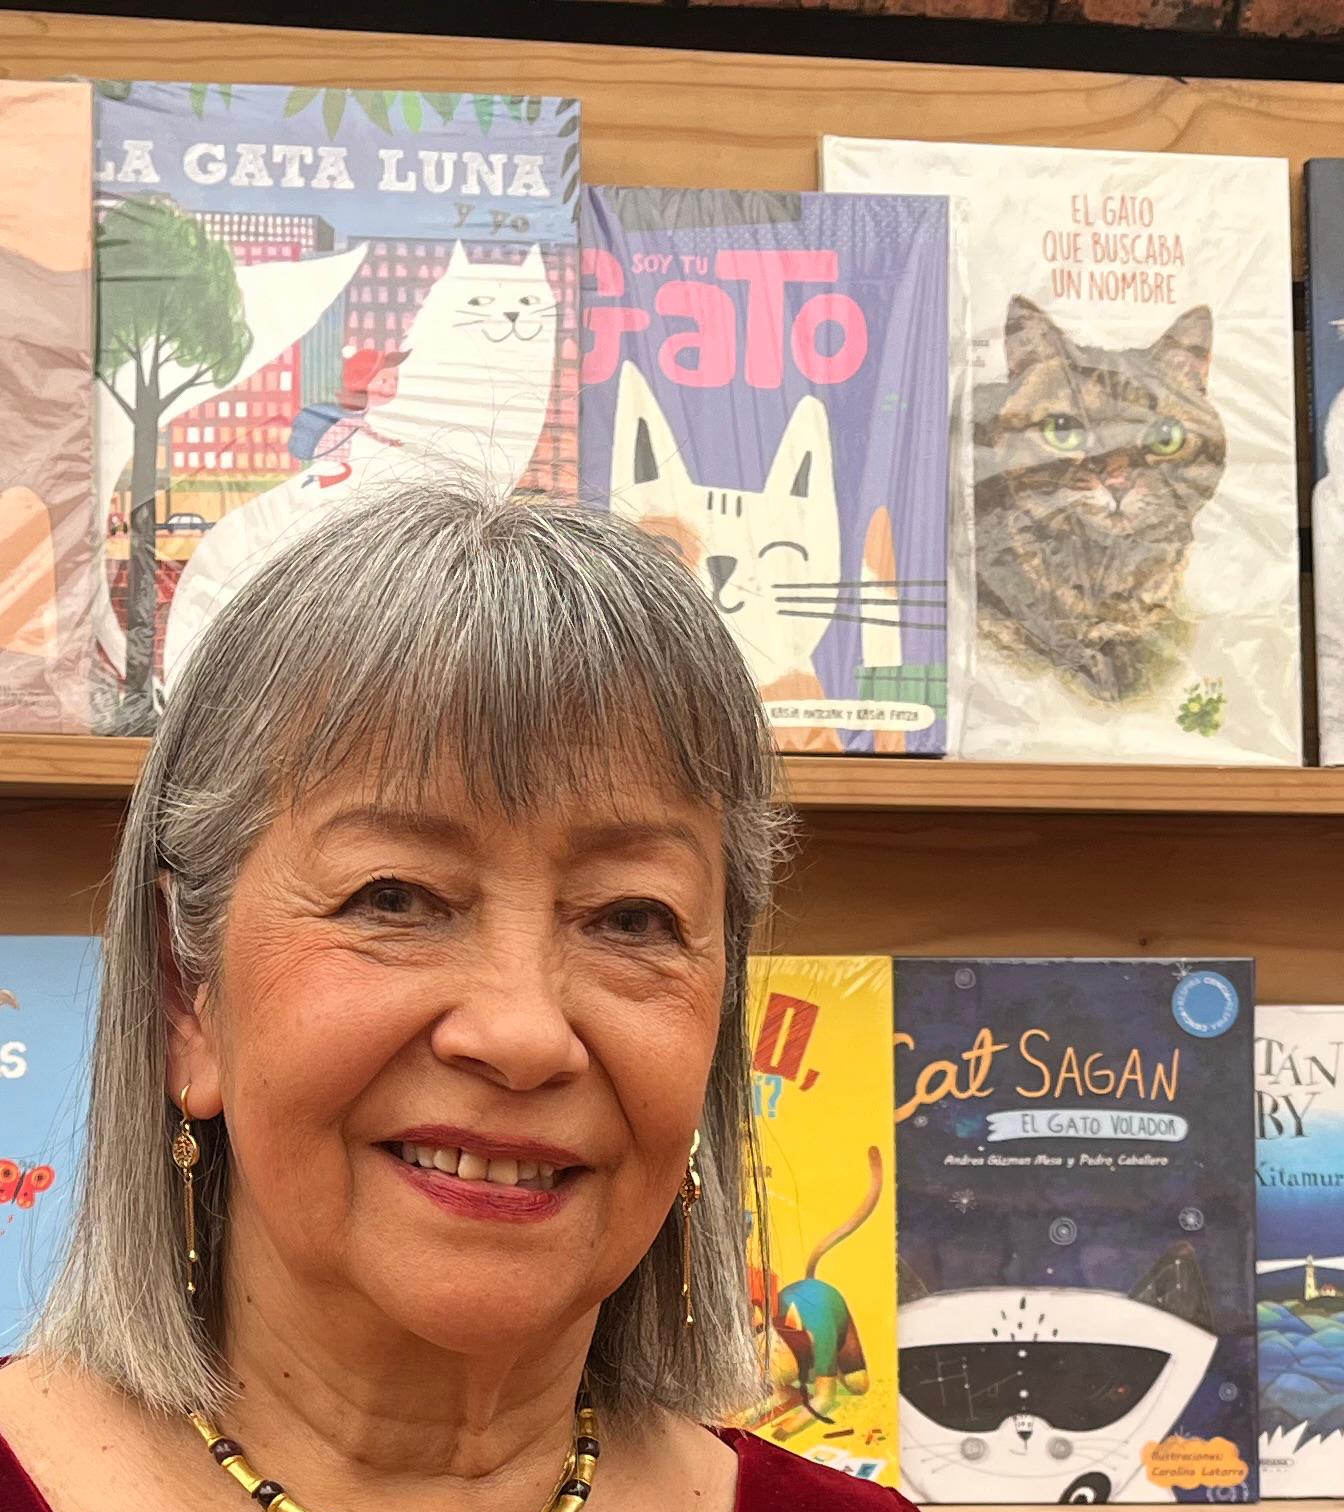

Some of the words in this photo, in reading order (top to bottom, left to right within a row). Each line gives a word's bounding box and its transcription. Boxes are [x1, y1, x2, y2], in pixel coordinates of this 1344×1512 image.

[183, 144, 354, 190] GATA
[379, 149, 551, 198] LUNA
[1071, 195, 1095, 226] EL
[1103, 195, 1154, 229] GATO
[632, 253, 673, 274] SOY
[680, 255, 708, 276] TU
[1042, 230, 1085, 264] QUE
[1091, 231, 1185, 267] BUSCABA
[1052, 268, 1084, 301] UN
[1089, 271, 1177, 306] NOMBRE
[1015, 1028, 1181, 1102] SAGAN
[1021, 1113, 1039, 1133] EL
[1048, 1113, 1100, 1135] GATO
[1110, 1114, 1176, 1138] VOLADOR
